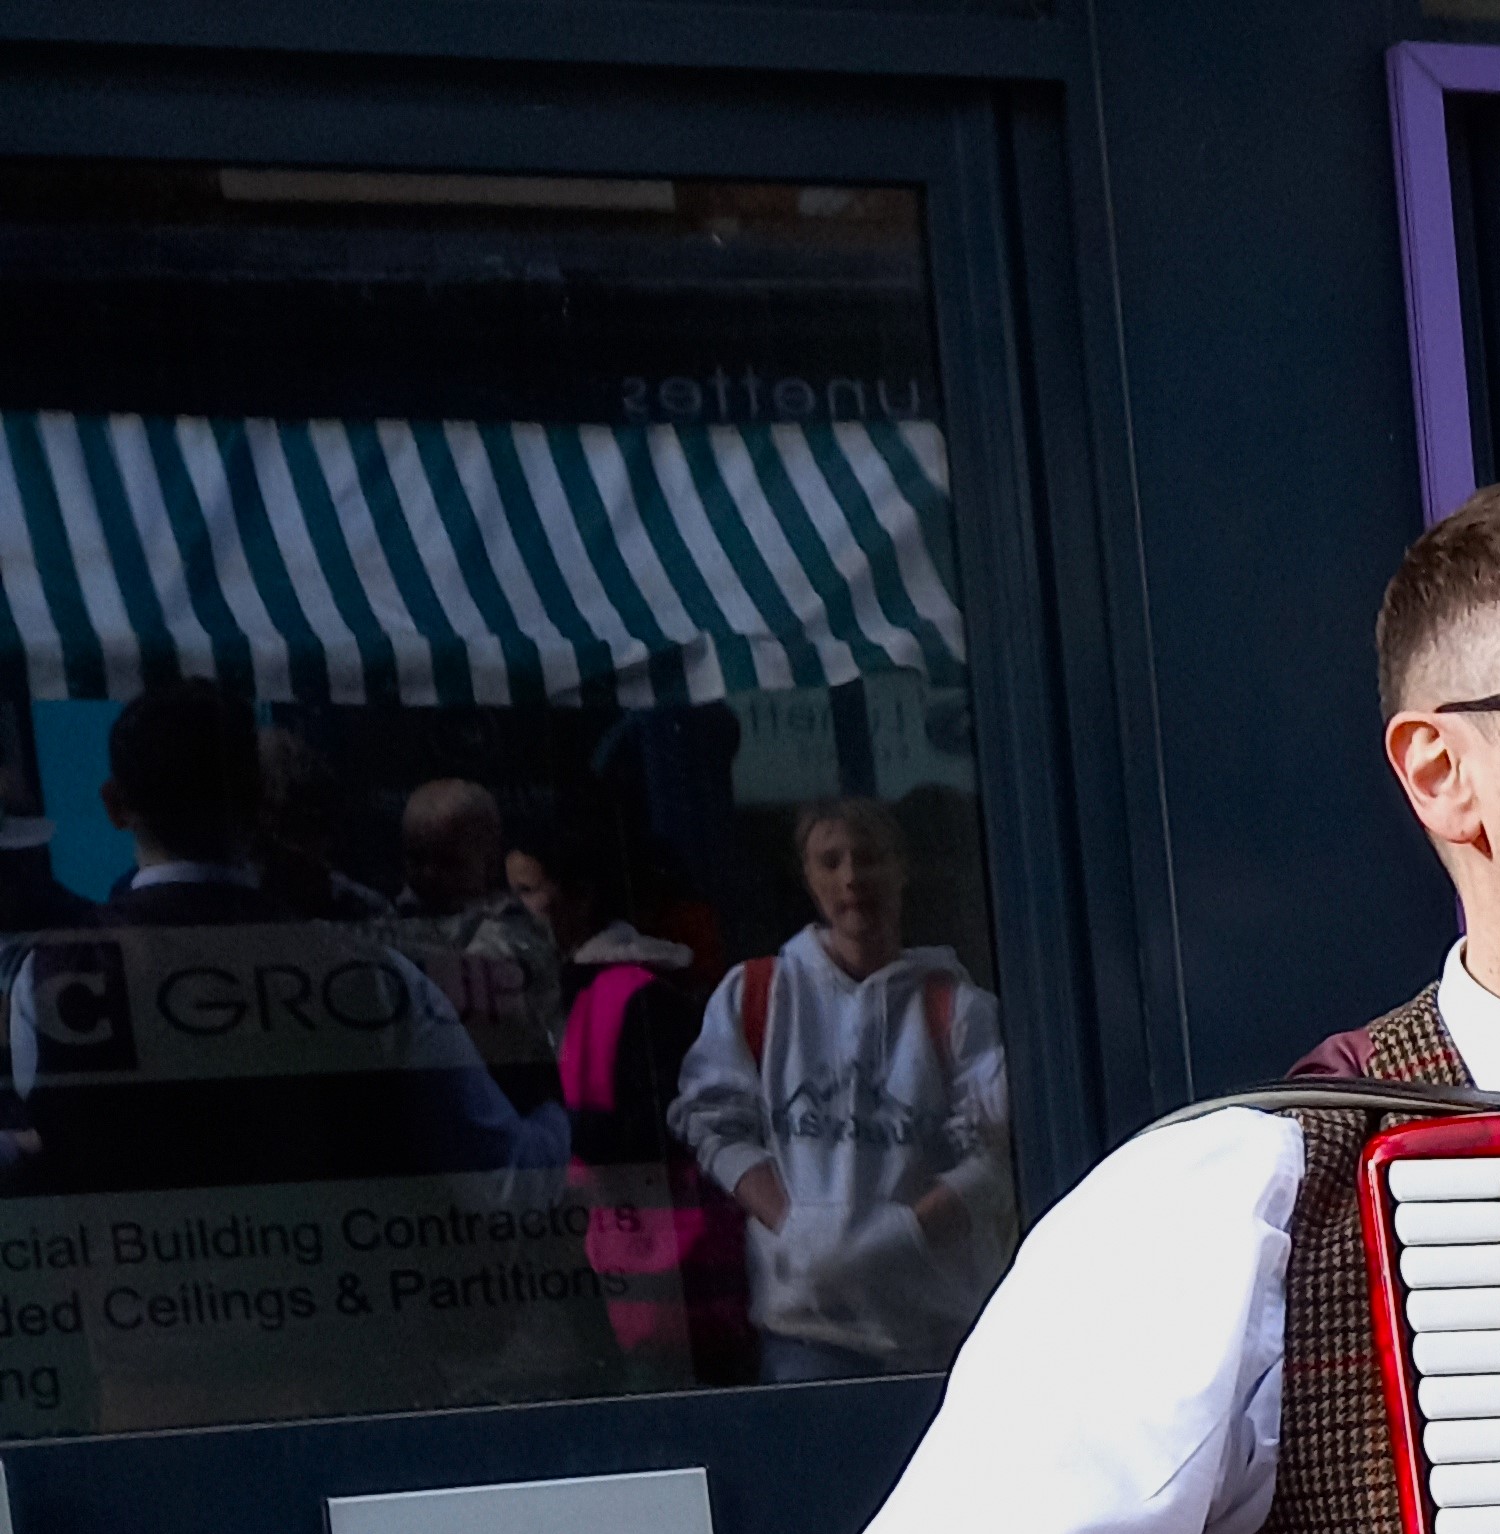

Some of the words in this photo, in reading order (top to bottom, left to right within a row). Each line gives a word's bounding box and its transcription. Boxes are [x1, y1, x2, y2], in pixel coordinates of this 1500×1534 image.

[156, 954, 535, 1036] GROUP
[1, 1223, 91, 1271] cial
[111, 1217, 323, 1265] Building
[342, 1200, 641, 1254] Contractors
[103, 1280, 316, 1331] Ceilings
[336, 1272, 373, 1315] &
[390, 1261, 630, 1312] Partitions
